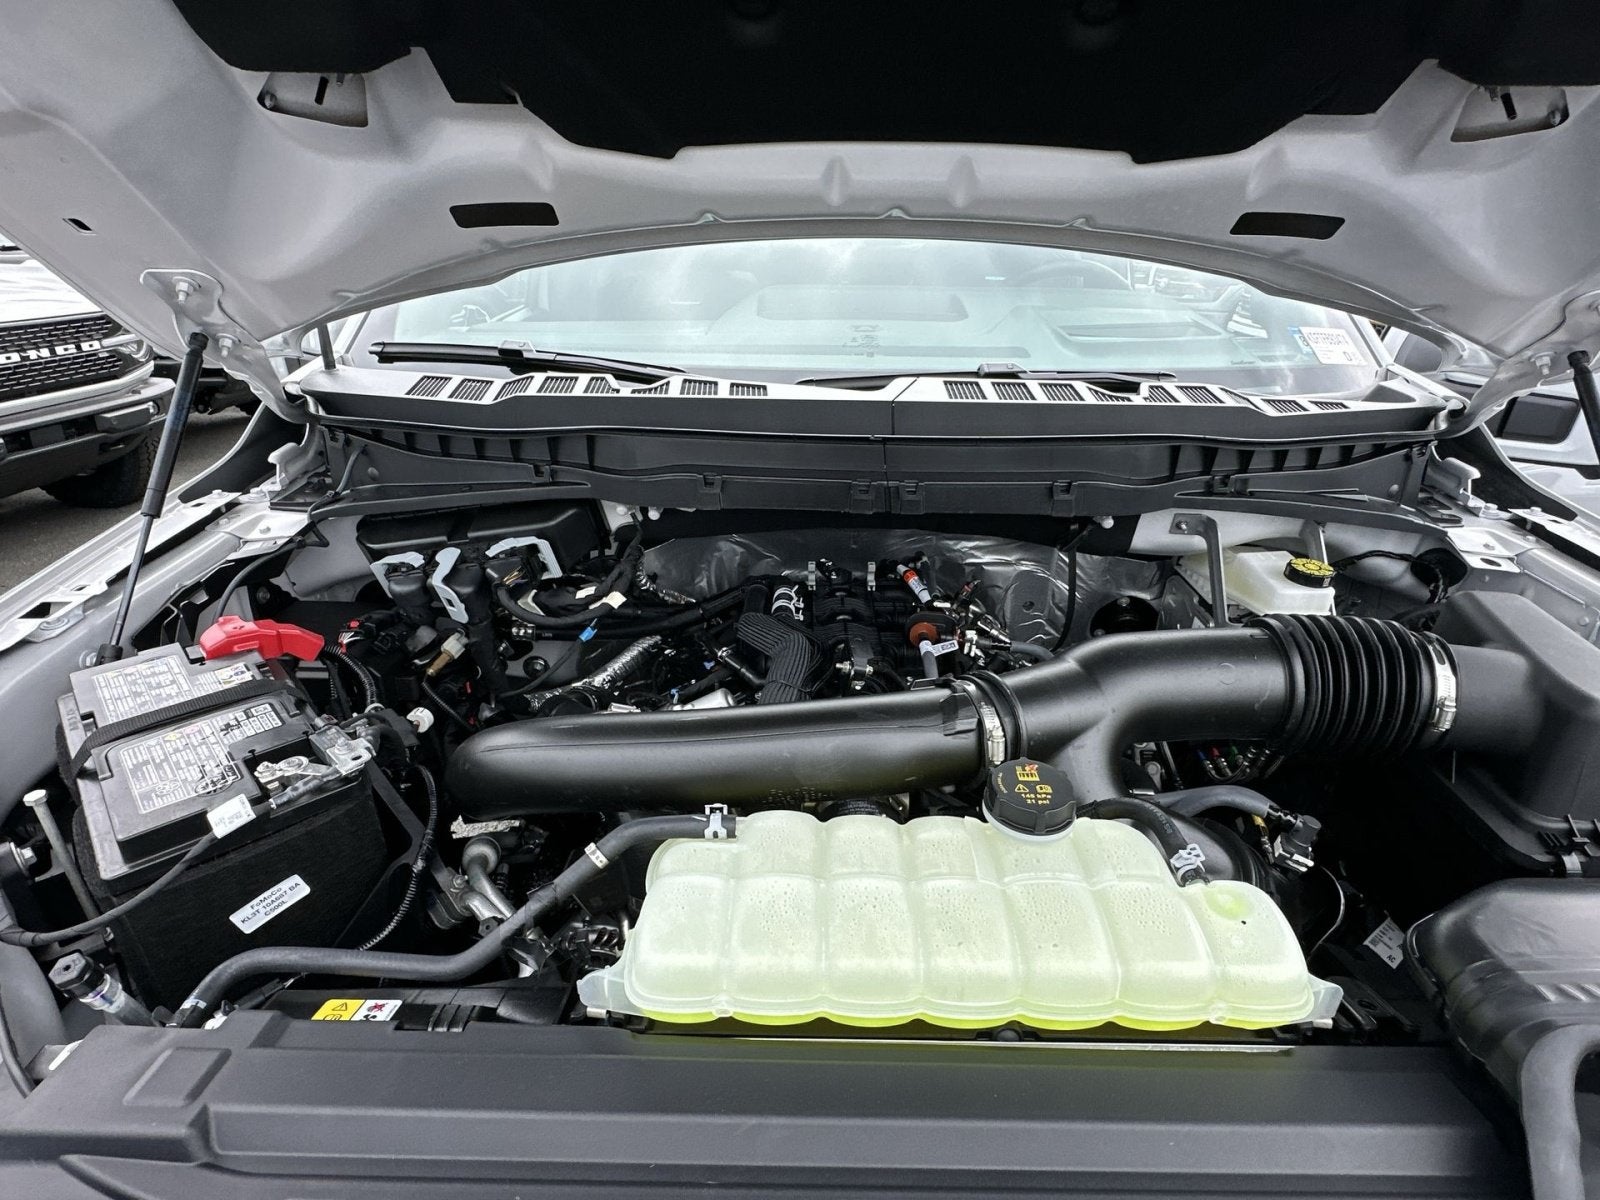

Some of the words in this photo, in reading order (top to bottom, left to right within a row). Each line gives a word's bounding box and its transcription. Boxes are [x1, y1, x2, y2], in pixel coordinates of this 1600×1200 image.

[240, 908, 261, 924] KL3T
[288, 882, 301, 892] BA
[250, 887, 282, 910] FoMoCo
